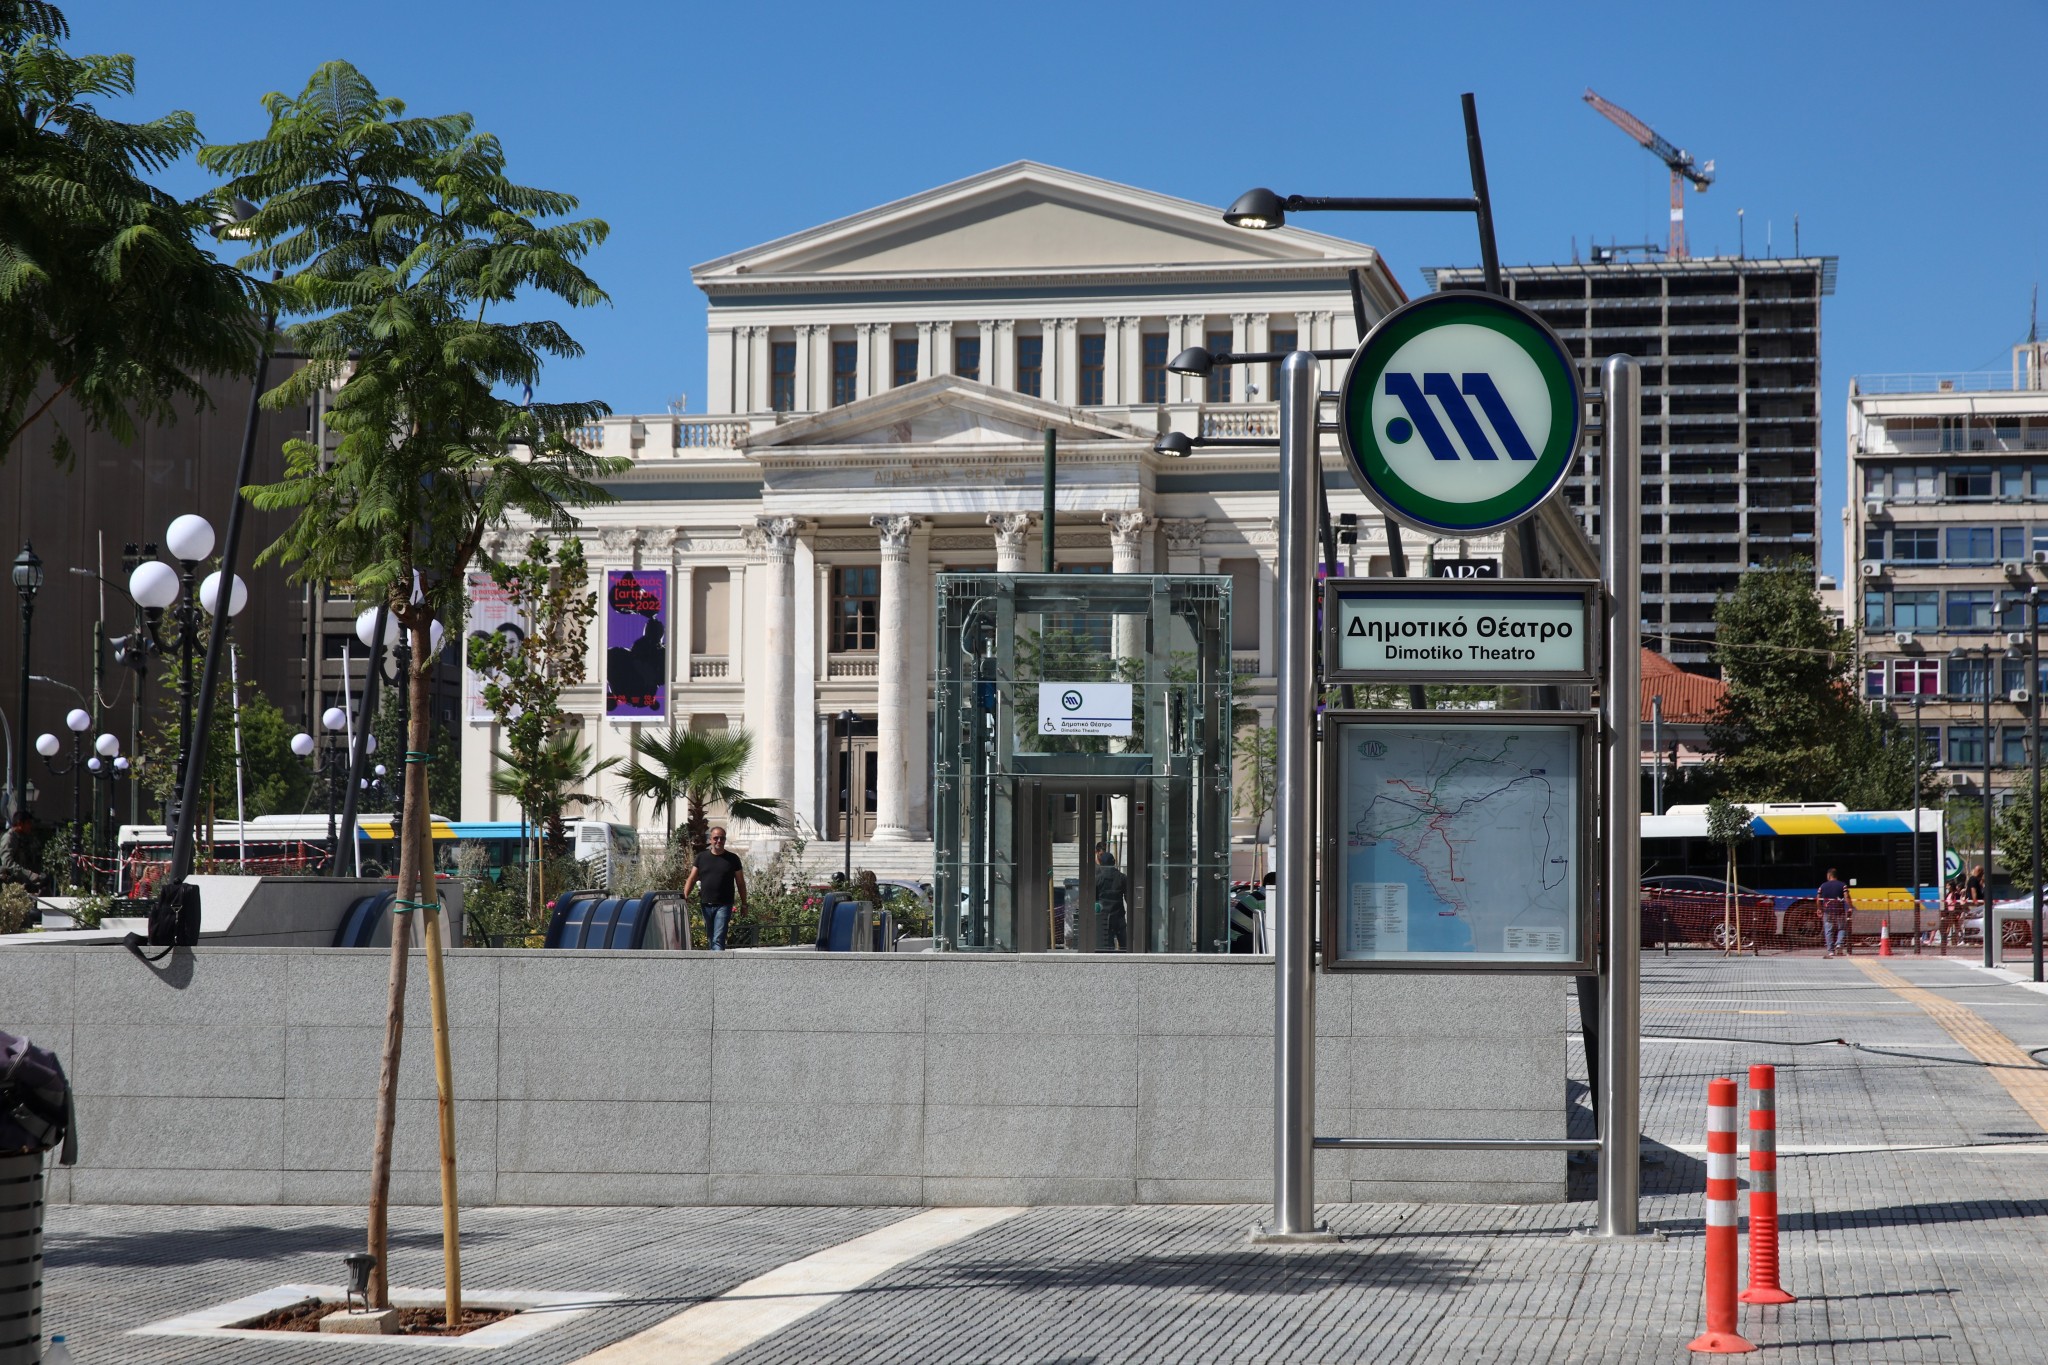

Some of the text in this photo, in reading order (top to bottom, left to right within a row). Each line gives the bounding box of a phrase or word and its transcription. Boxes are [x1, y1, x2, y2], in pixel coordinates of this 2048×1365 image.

[636, 601, 661, 610] 2022
[1347, 616, 1573, 643] Δημοτικό Θέατρο
[1385, 645, 1536, 660] Dimotiko Theatro
